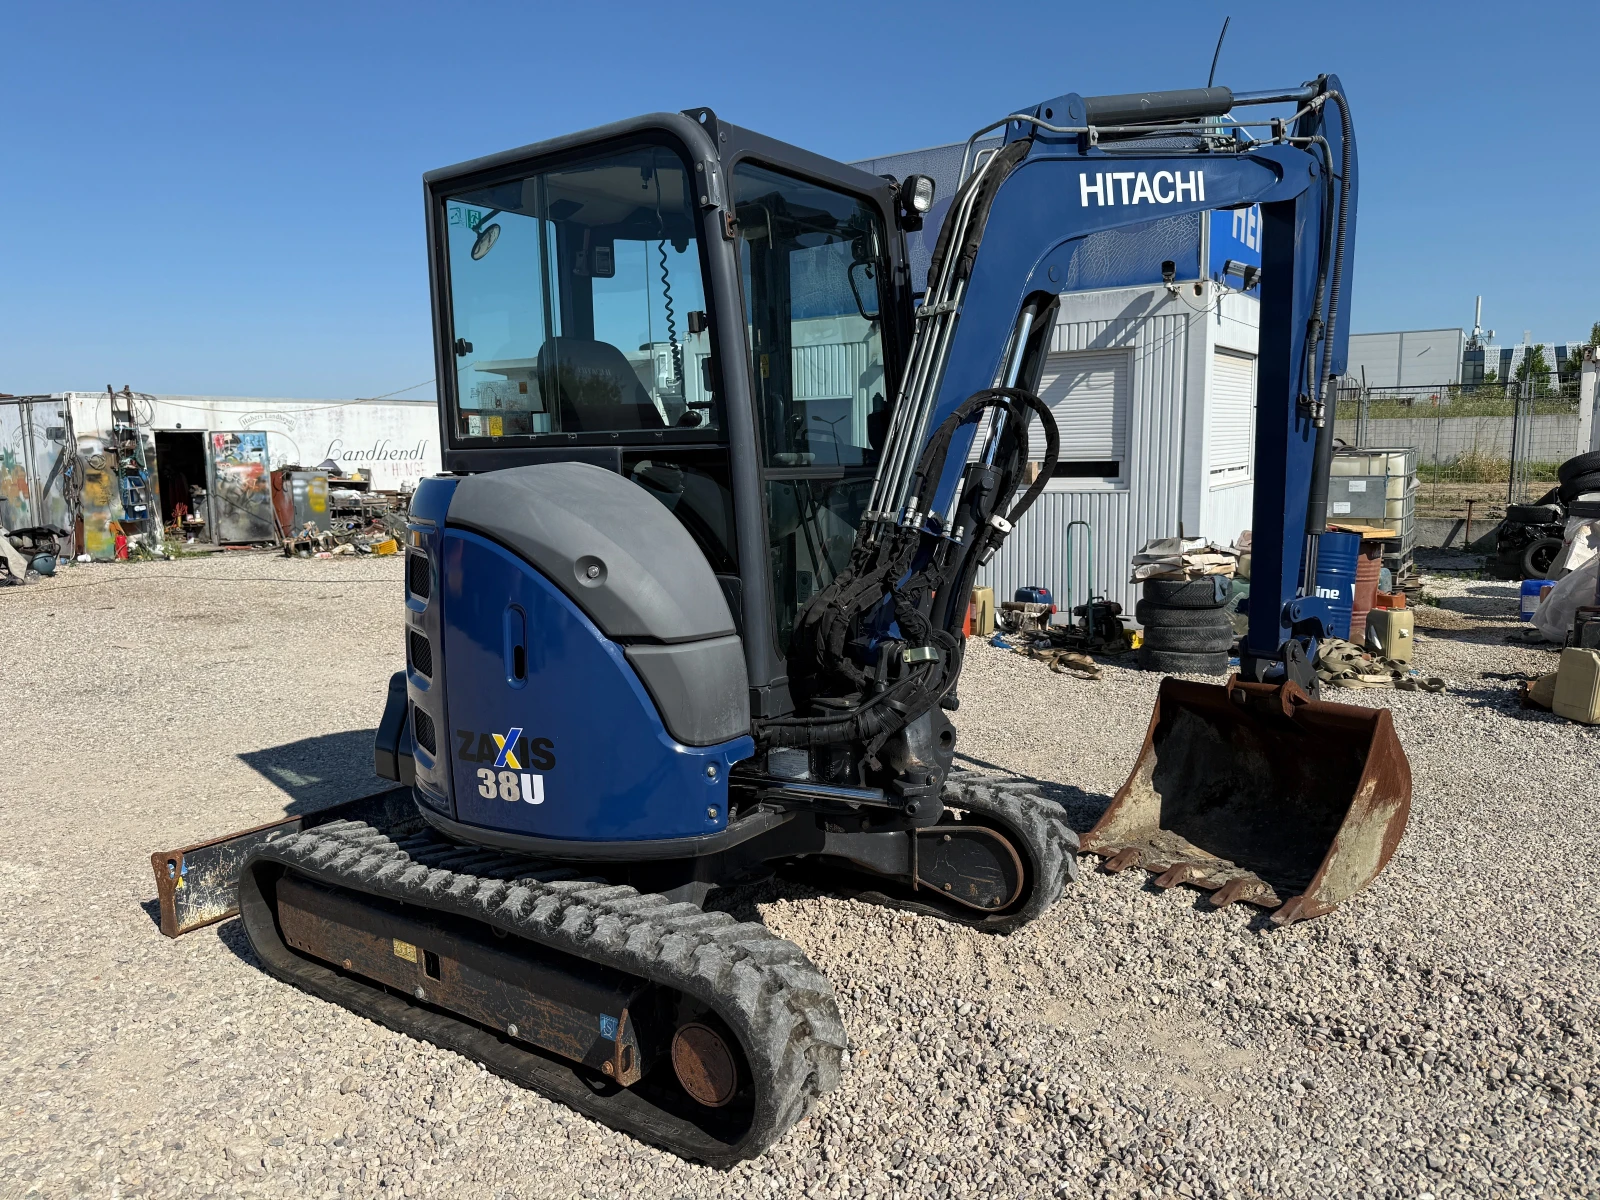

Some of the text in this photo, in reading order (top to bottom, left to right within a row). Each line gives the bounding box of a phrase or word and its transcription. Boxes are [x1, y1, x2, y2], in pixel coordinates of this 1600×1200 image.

[1079, 170, 1205, 207] HITACHI
[325, 438, 429, 462] Landhendl
[456, 727, 556, 771] ZAXIS
[477, 768, 545, 805] 38U
